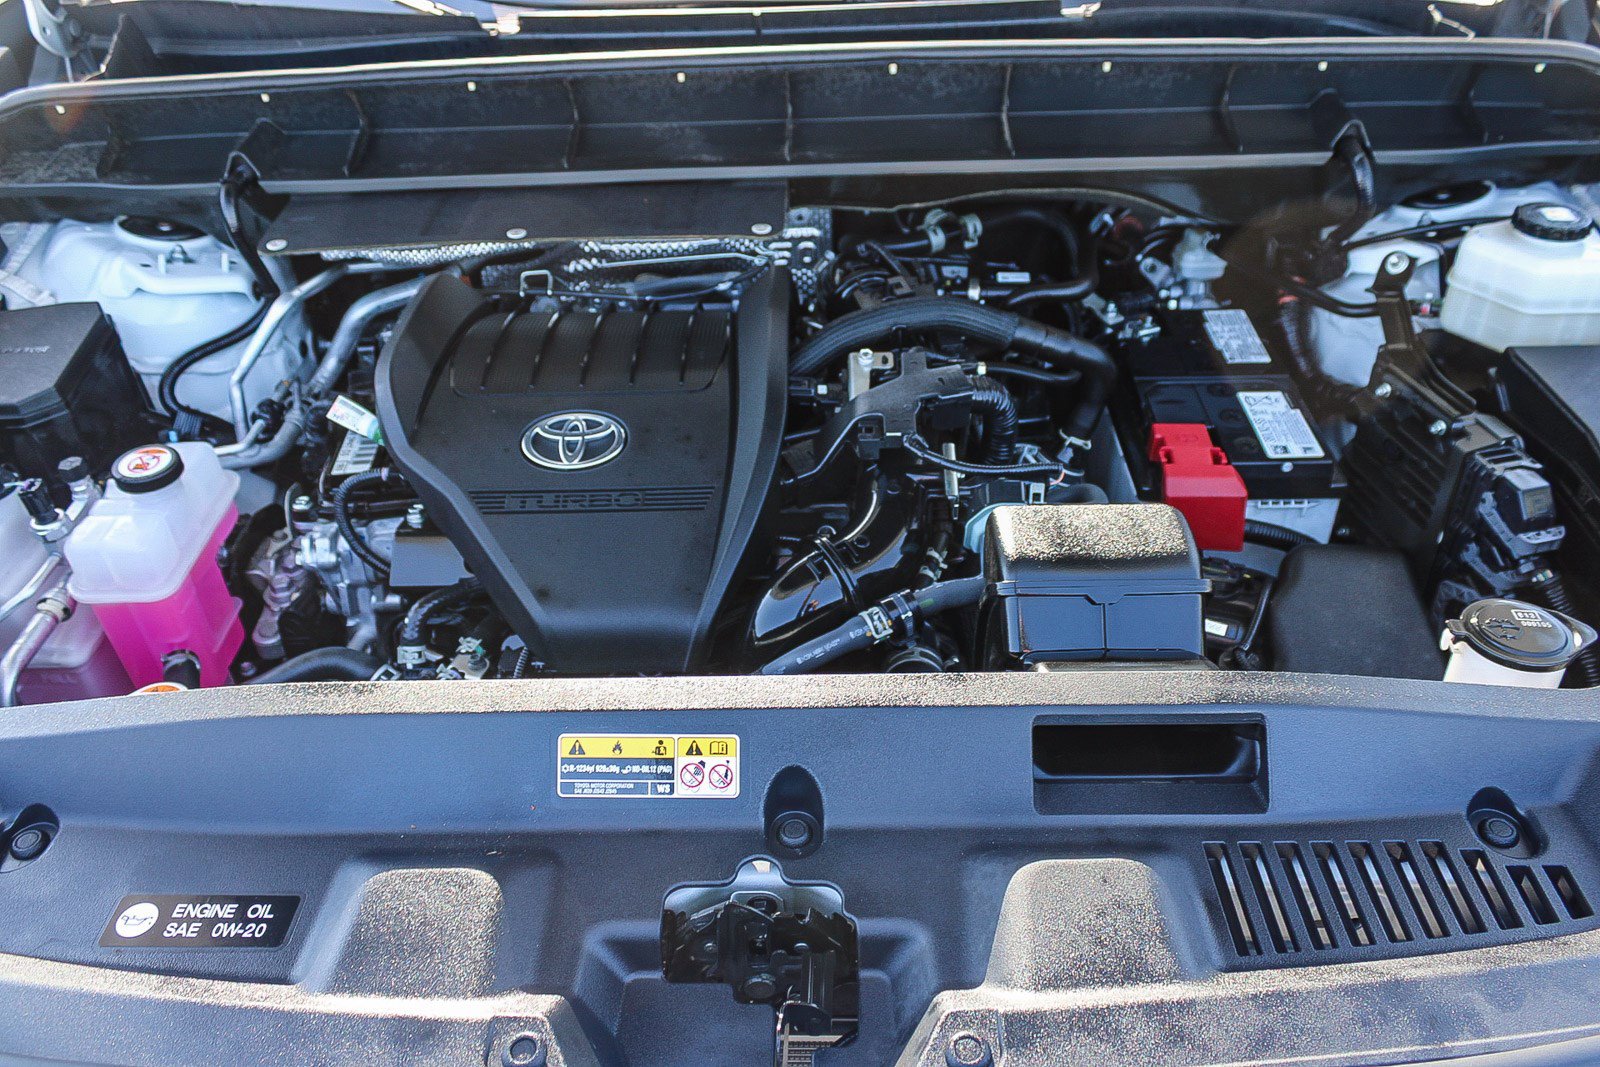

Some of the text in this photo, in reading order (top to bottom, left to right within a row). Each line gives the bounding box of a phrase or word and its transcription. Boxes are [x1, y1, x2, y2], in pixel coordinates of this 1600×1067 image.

[505, 492, 644, 510] TURBO
[171, 903, 275, 919] ENGINE OIL
[162, 922, 268, 938] SAE 0W-20
